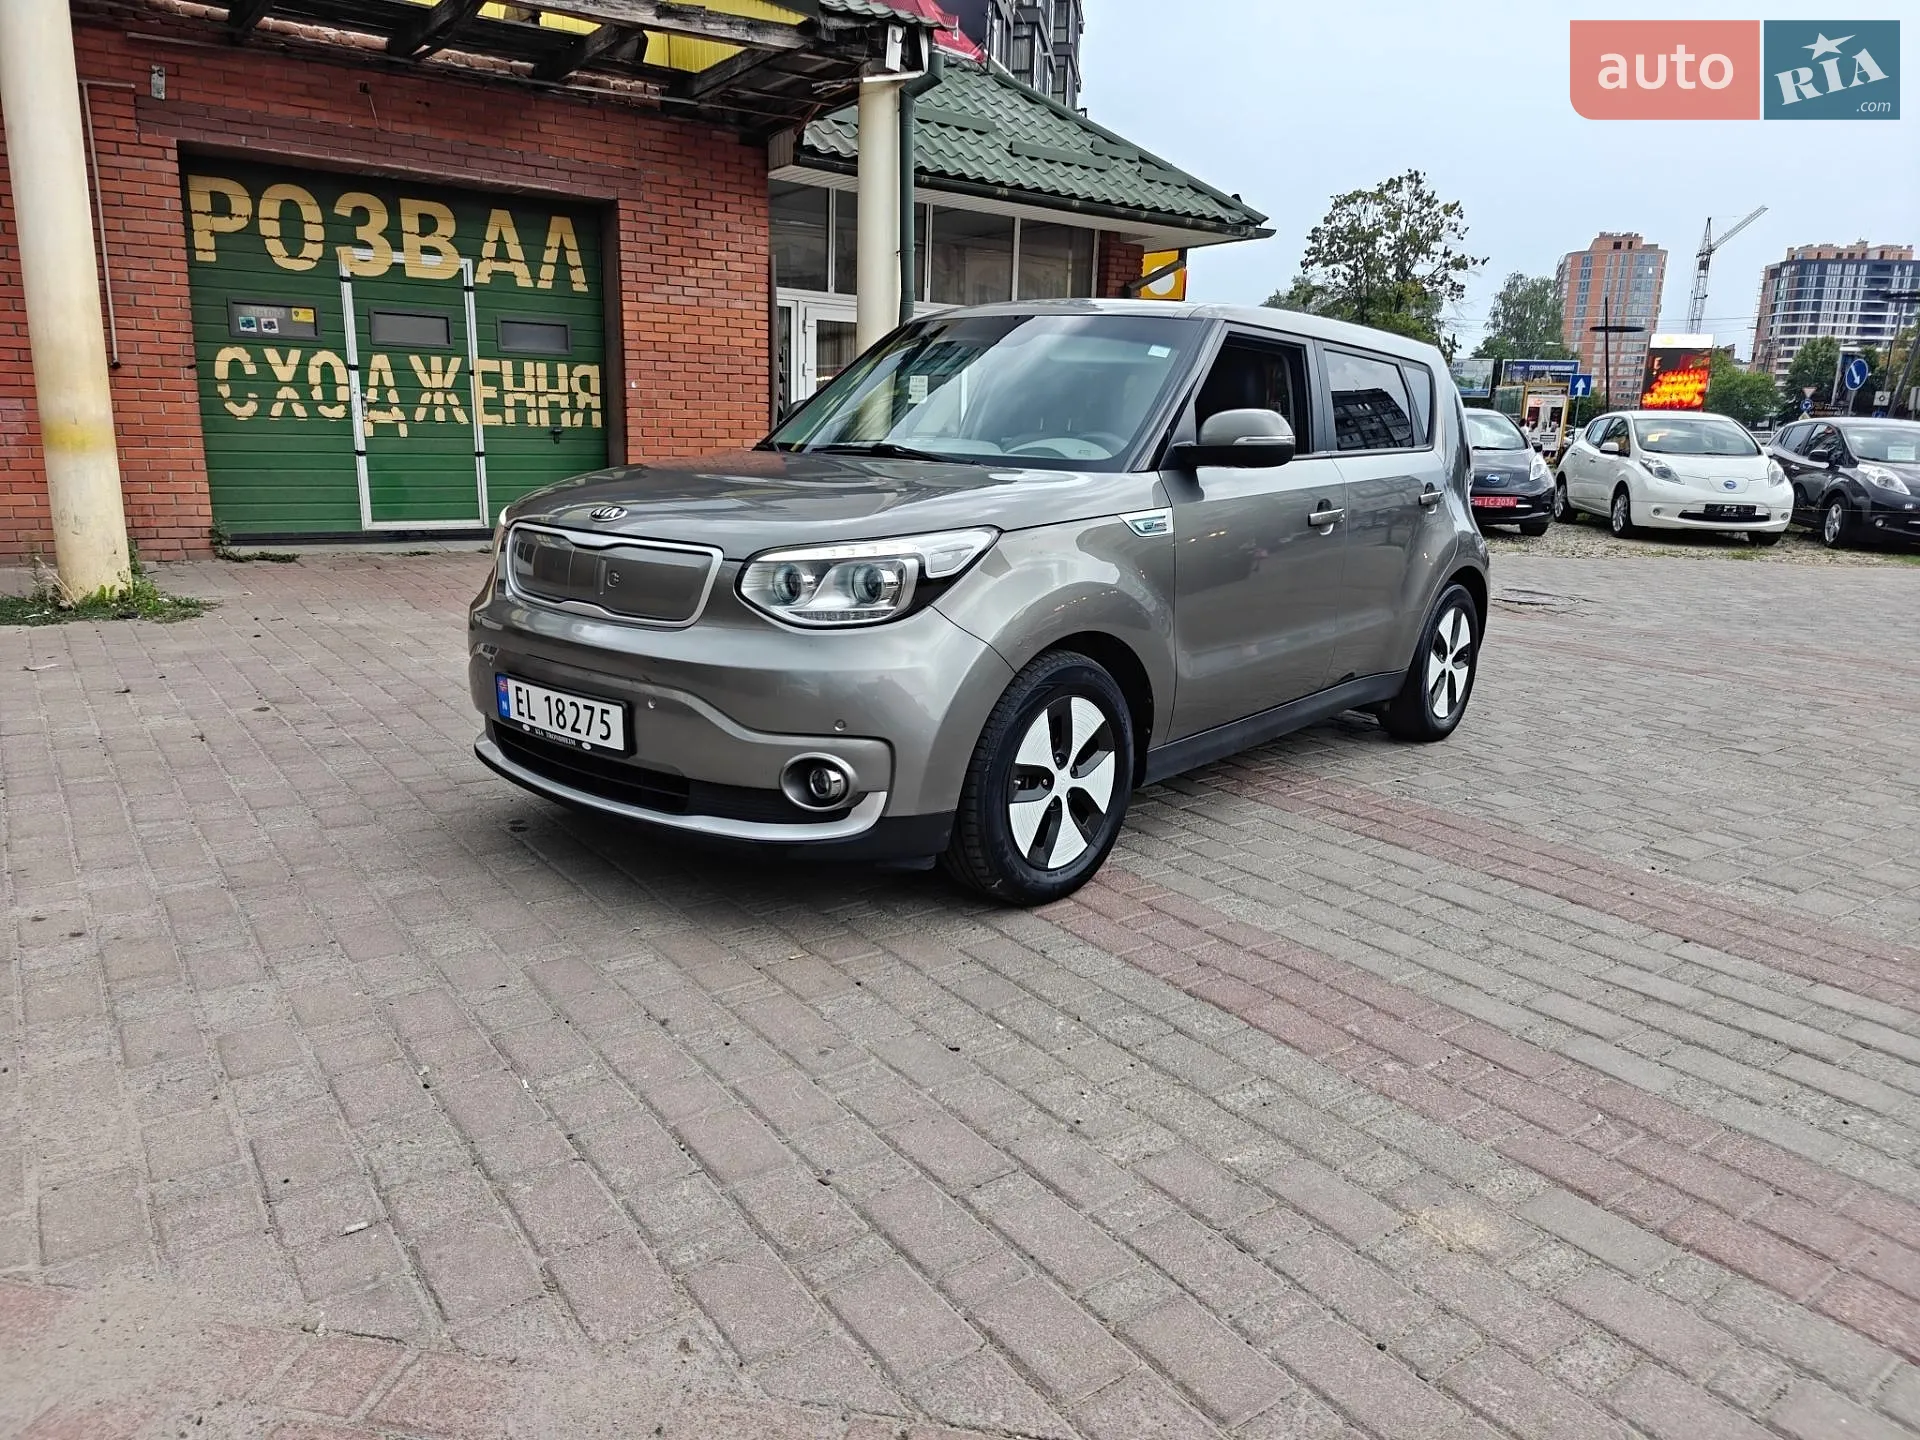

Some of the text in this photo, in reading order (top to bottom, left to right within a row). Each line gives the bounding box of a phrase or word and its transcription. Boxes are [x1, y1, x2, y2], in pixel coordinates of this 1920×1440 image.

[187, 174, 590, 293] РОЗВАЛ
[213, 345, 603, 438] СХОДЖЕННЯ
[515, 686, 612, 741] EL 18275
